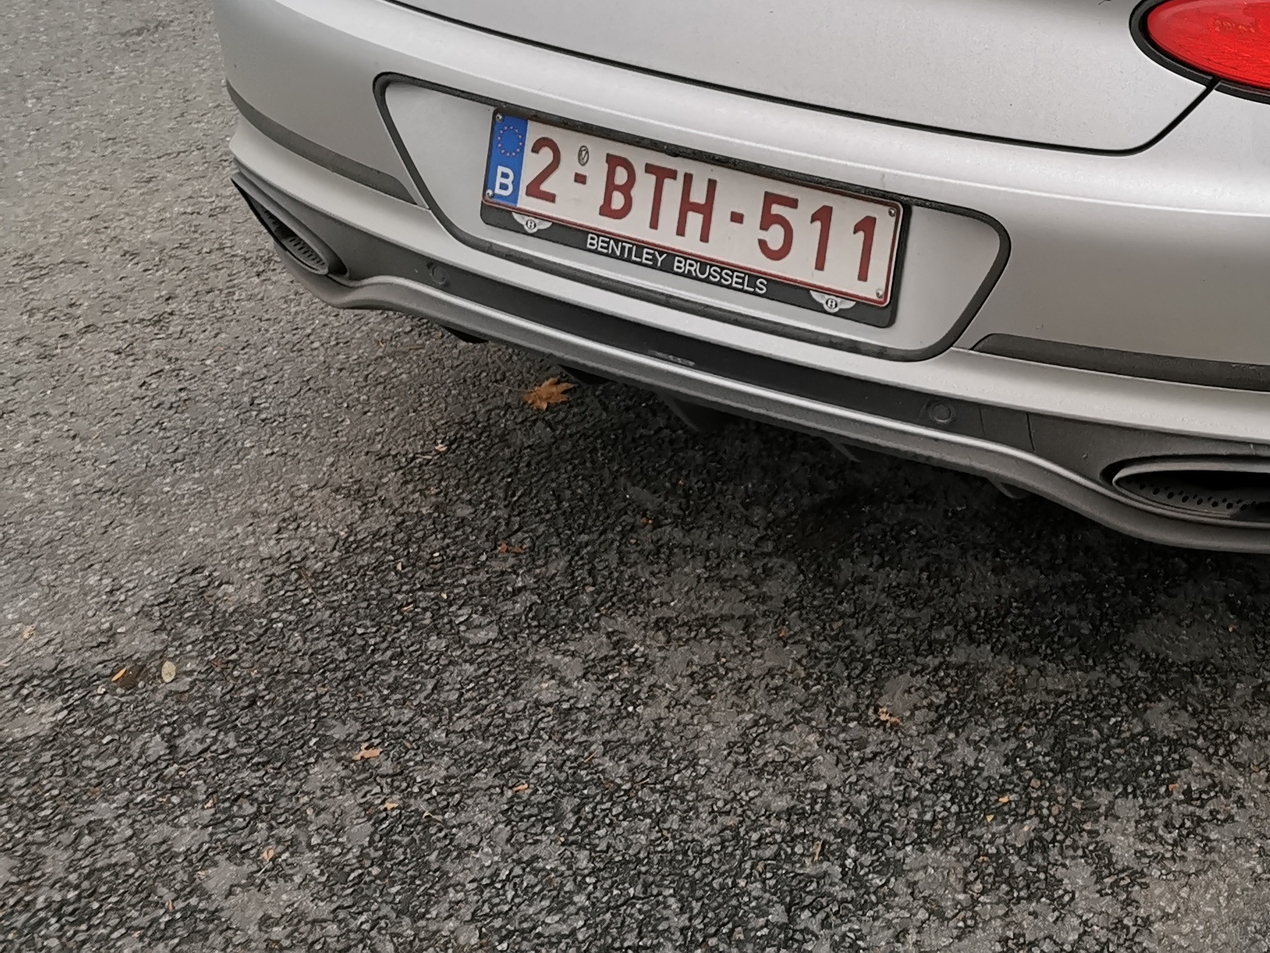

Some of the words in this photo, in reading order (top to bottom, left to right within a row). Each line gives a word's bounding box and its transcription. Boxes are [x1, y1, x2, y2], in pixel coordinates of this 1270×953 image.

[494, 165, 515, 196] B
[525, 136, 877, 283] 2-BTH-511
[586, 233, 668, 268] BENTLEY
[673, 256, 768, 294] BRUSSELS
